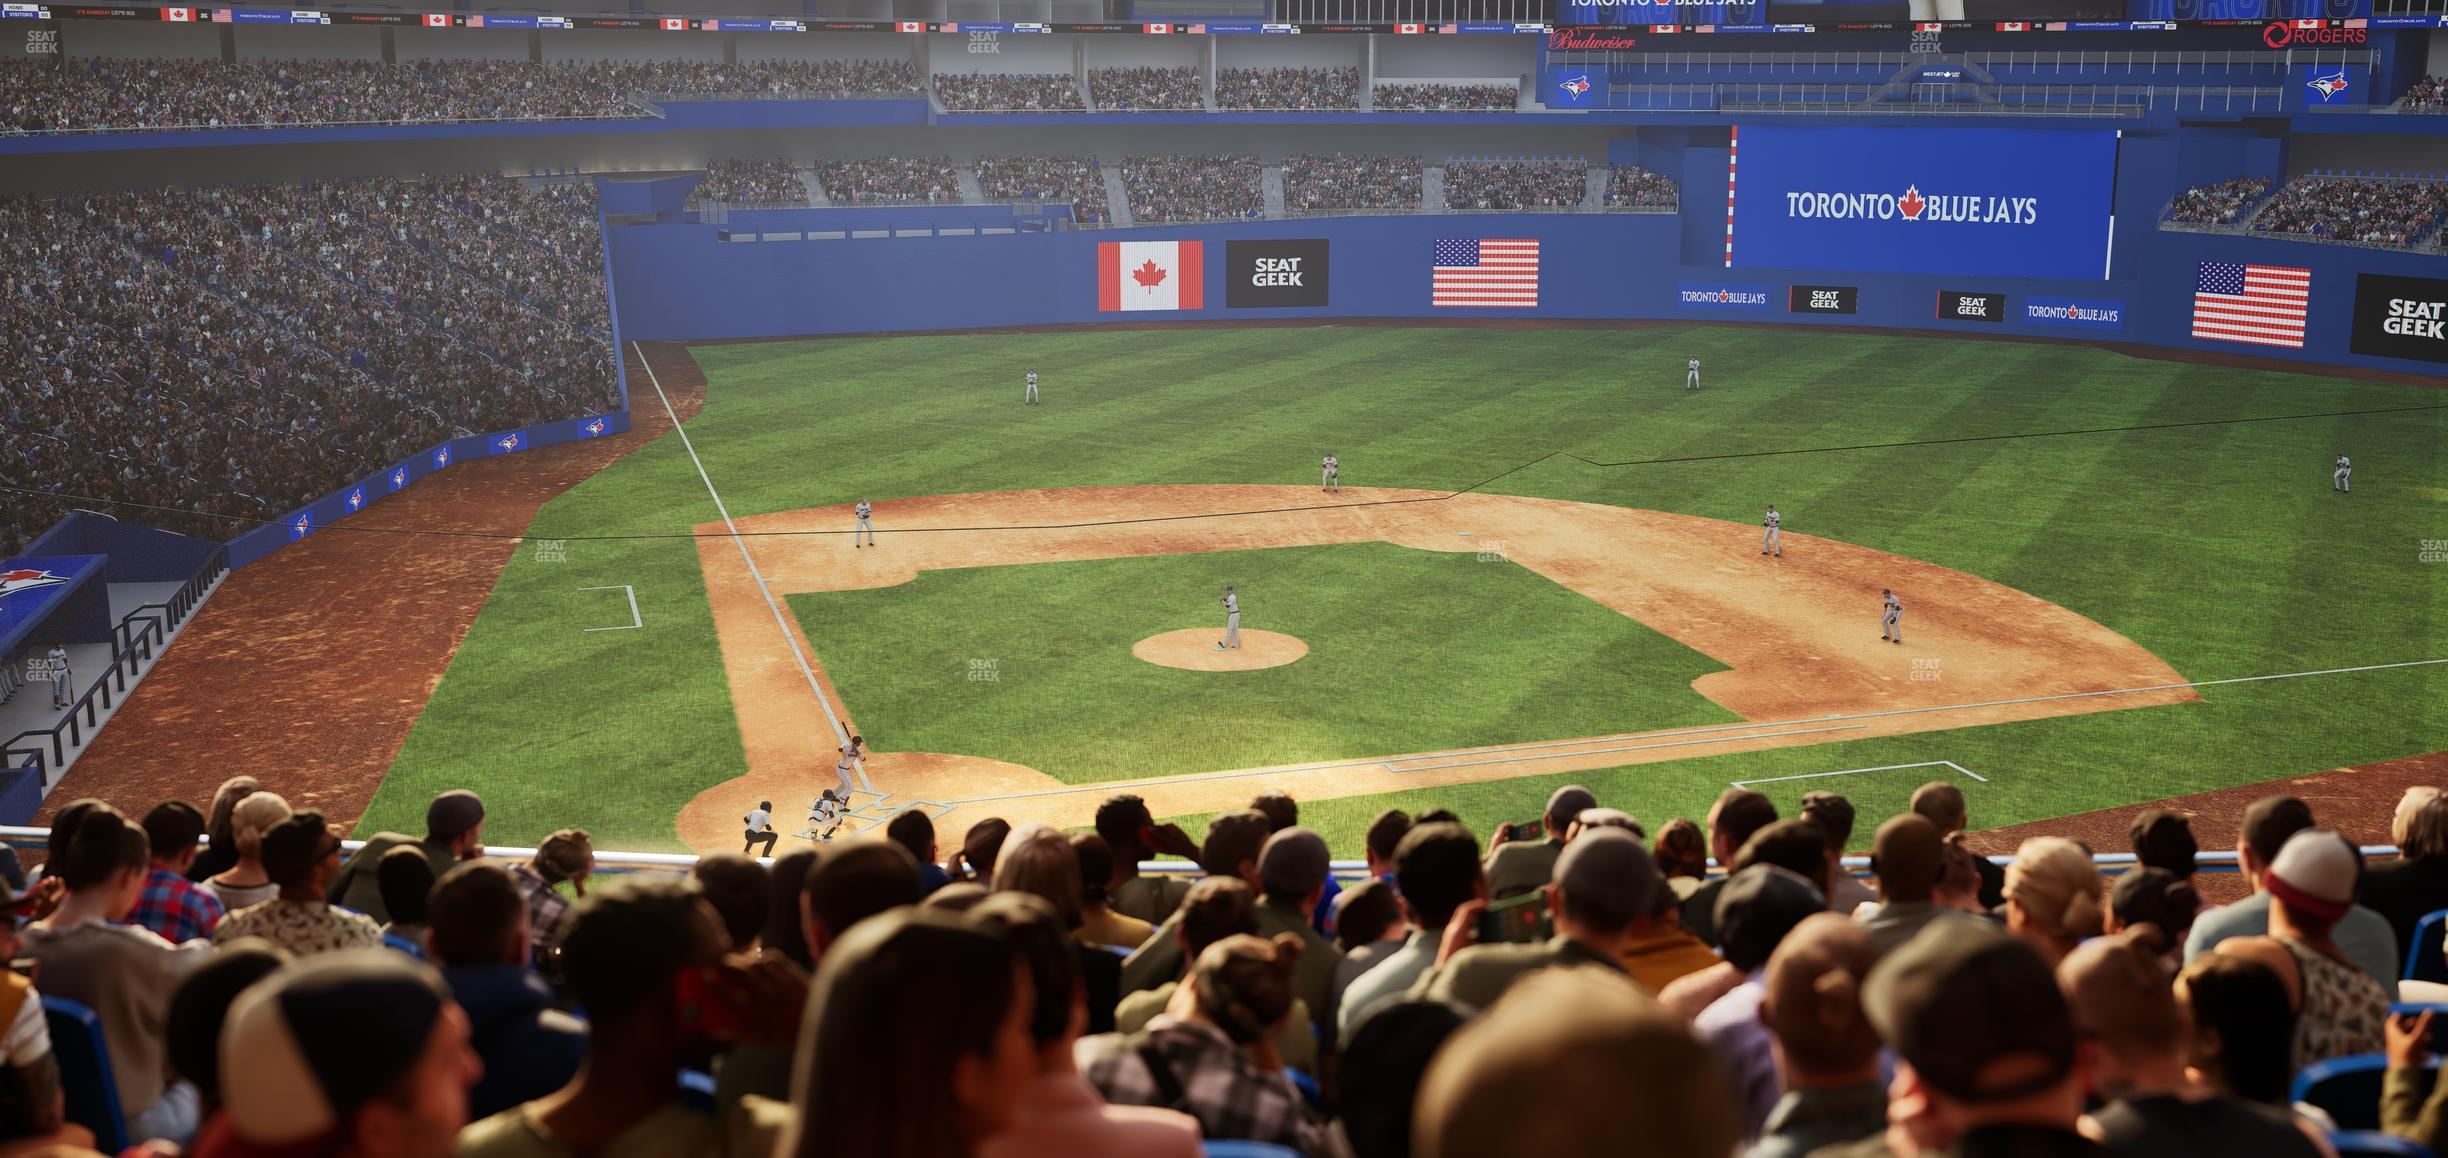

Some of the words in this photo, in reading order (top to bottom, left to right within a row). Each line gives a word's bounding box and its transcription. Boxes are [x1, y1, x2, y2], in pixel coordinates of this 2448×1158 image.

[1549, 28, 1636, 49] Budweiser
[2293, 28, 2366, 43] ROGERS
[1787, 192, 1895, 220] TORONTO
[1927, 195, 1981, 223] BLUE
[1982, 196, 2037, 225] JAYS
[1255, 257, 1301, 272] SEAT
[1252, 271, 1303, 287] GEEK
[1682, 290, 1718, 303] TORONTO
[1728, 292, 1747, 304] BLUE
[1747, 292, 1766, 304] JAYS
[1812, 290, 1839, 300] SEAT
[1960, 296, 1987, 307] SEAT
[1810, 299, 1839, 309] GEEK
[1957, 305, 1986, 317] GEEK
[2388, 298, 2446, 320] SEAT
[2028, 305, 2067, 319] TORONTO
[2078, 307, 2098, 321] BLUE
[2098, 308, 2118, 322] JAYS
[2383, 317, 2446, 340] GEEK
